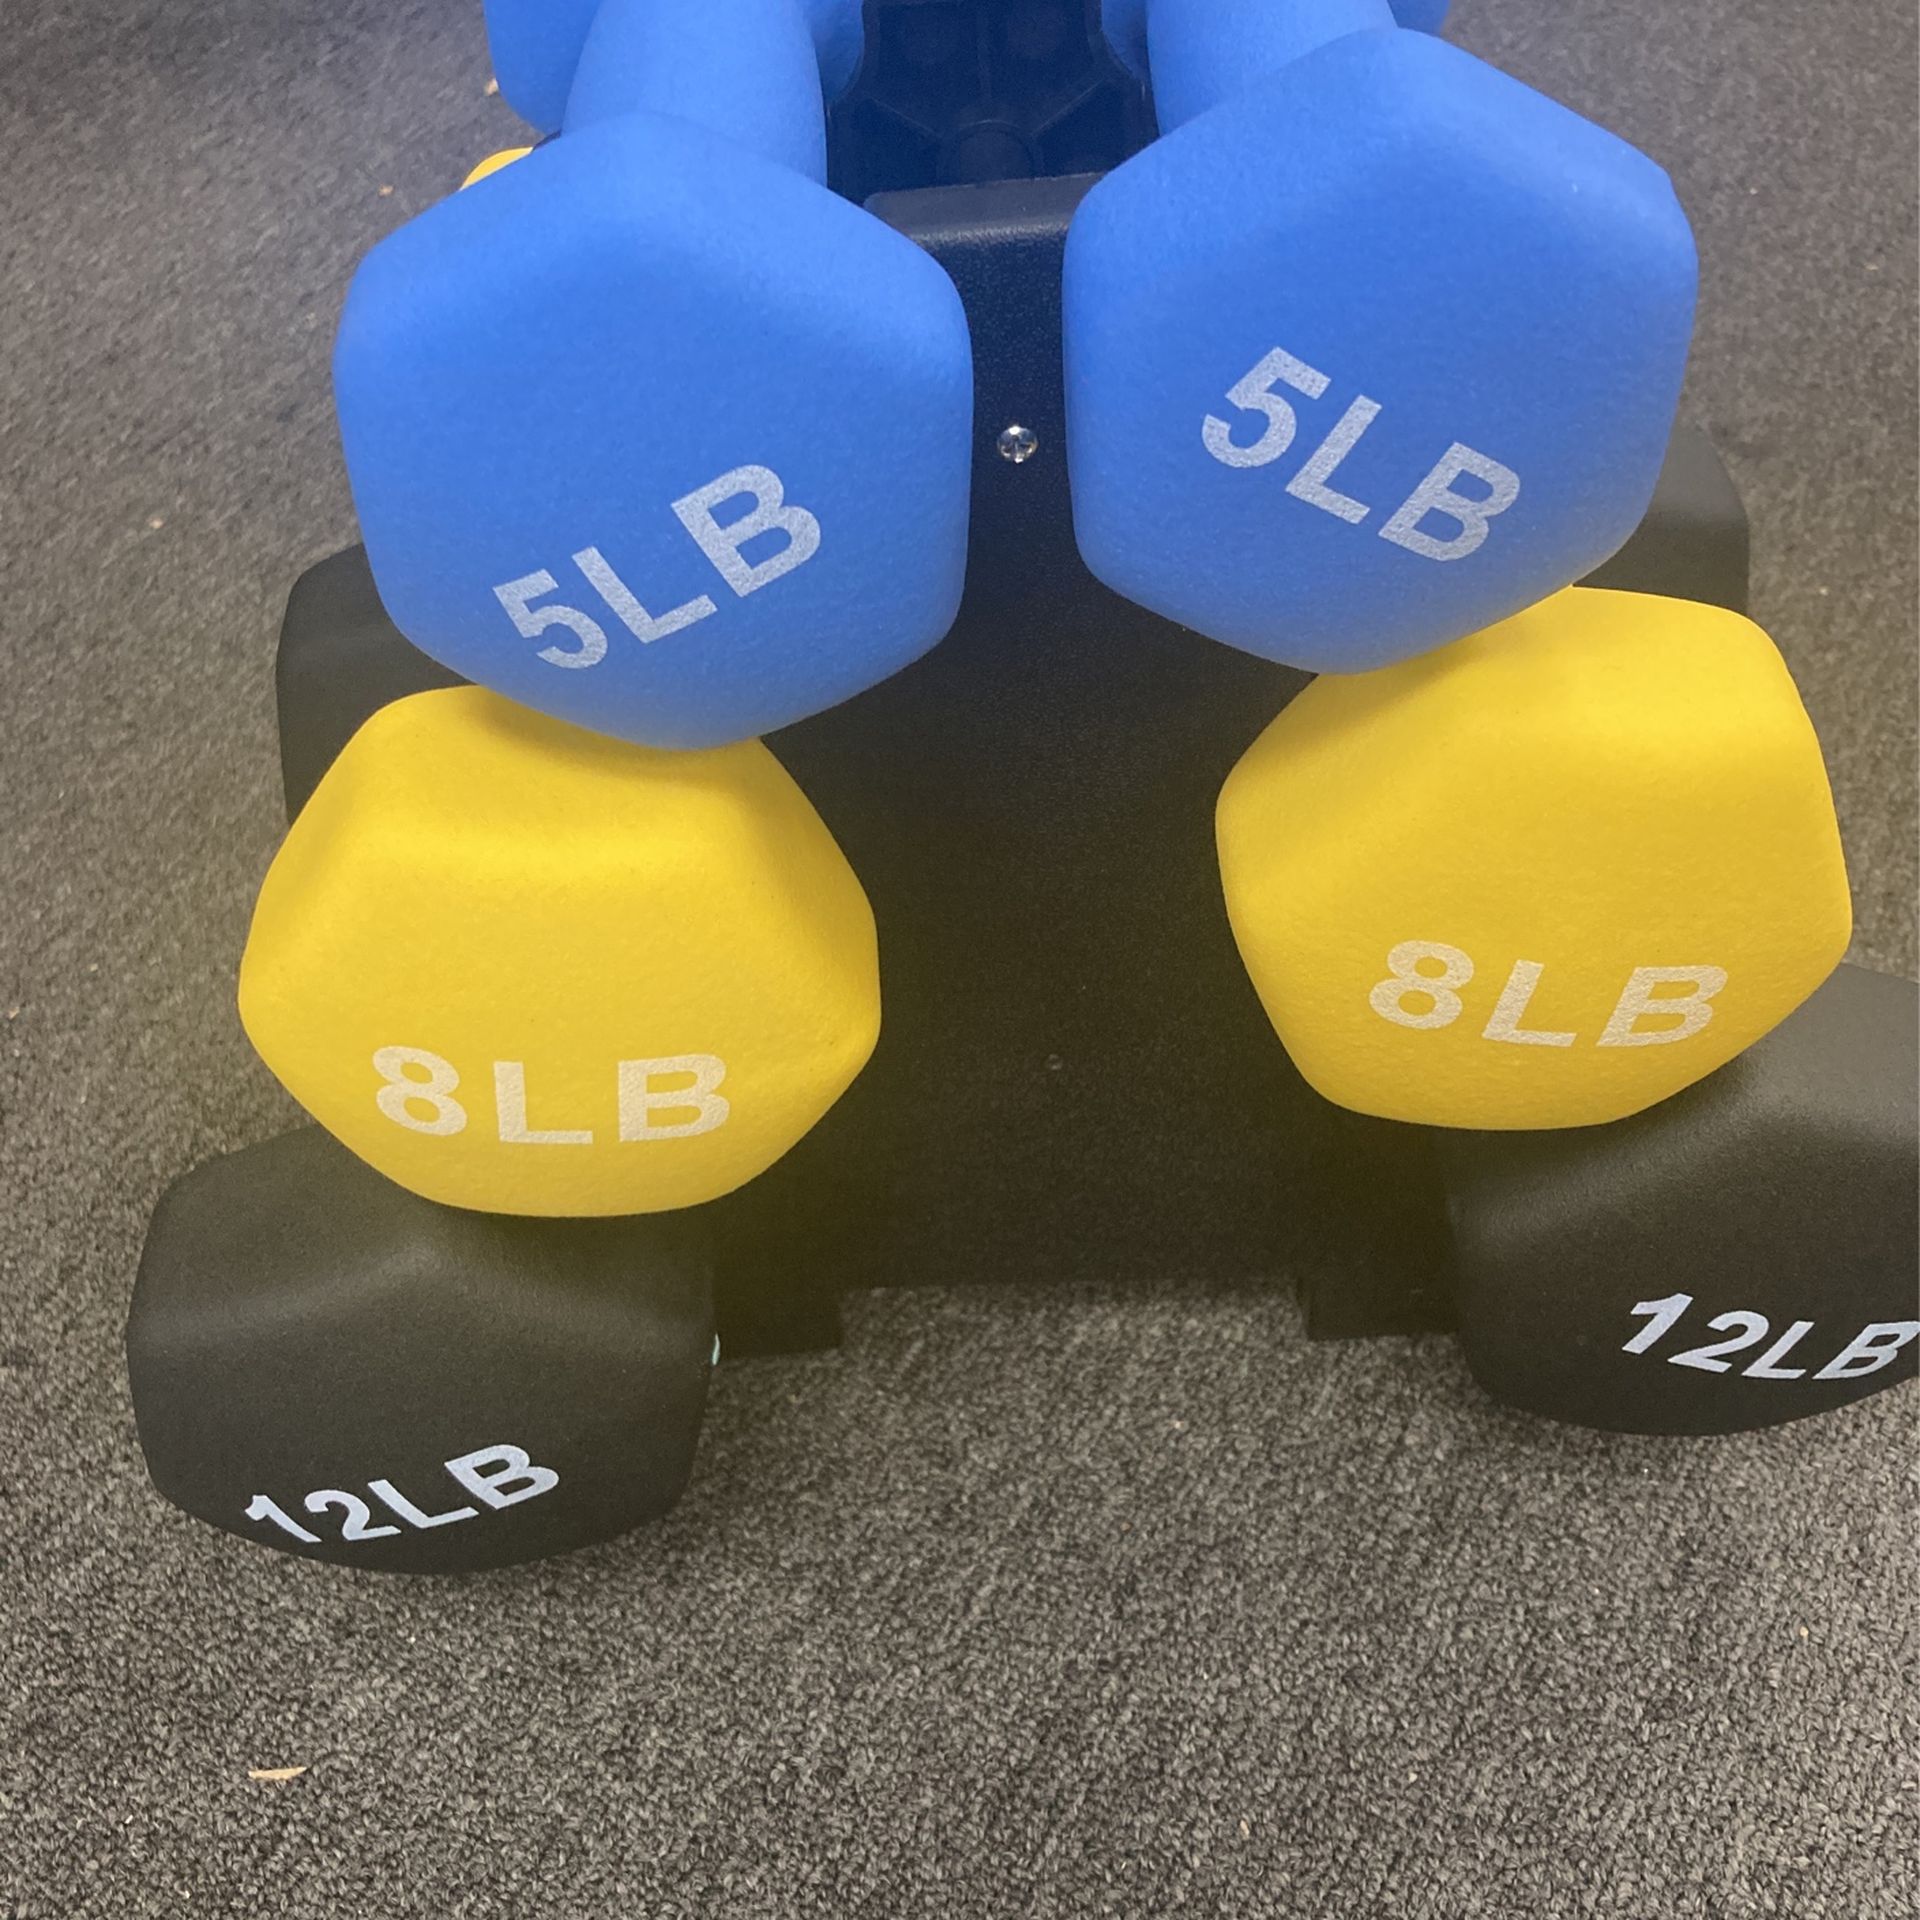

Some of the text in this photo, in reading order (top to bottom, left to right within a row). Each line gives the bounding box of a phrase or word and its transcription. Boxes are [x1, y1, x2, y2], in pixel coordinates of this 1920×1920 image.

[1202, 347, 1521, 563] 5LB
[493, 464, 821, 670] 5LB
[1622, 1293, 1920, 1380] 12LB
[245, 1444, 560, 1543] 12LB
